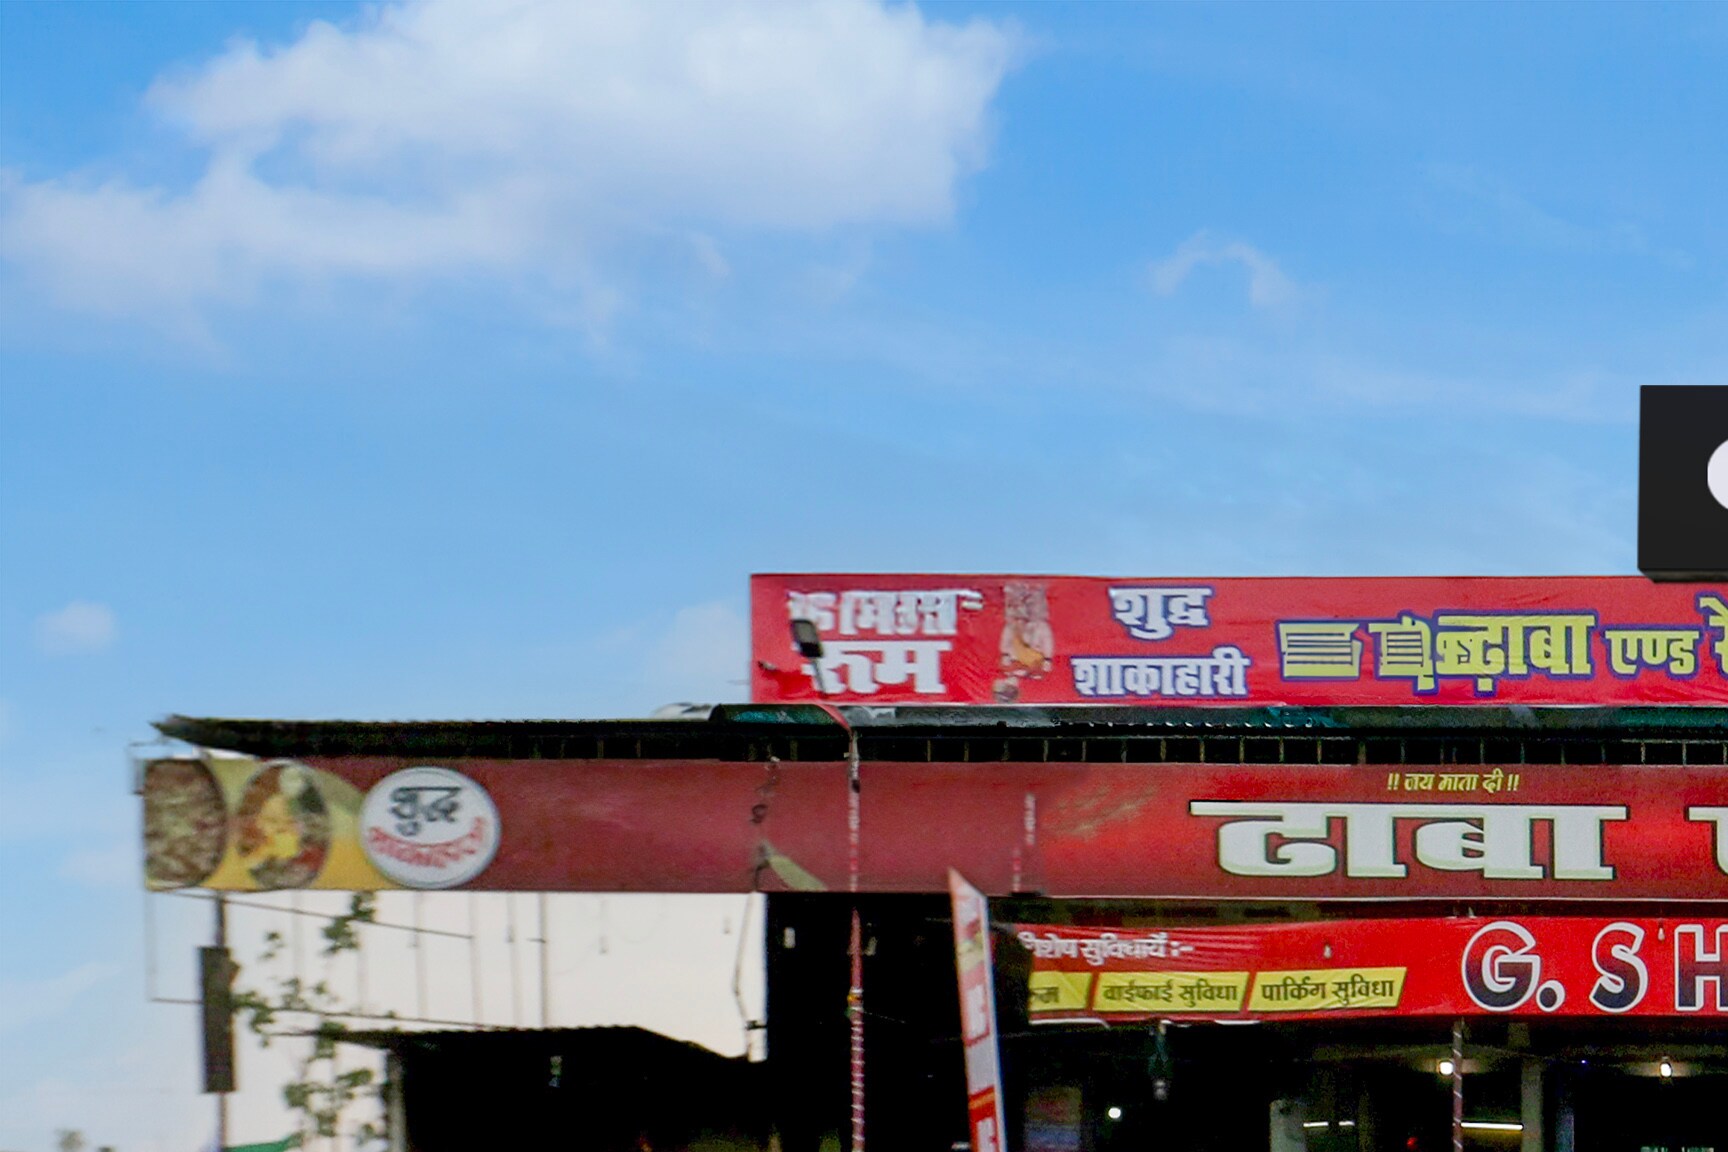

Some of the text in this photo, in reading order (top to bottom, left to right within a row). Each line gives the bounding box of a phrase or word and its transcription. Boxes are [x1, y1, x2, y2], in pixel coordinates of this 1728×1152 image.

[1110, 586, 1212, 638] शुद्ध
[1073, 646, 1250, 696] शाकाहारी
[1603, 627, 1703, 677] एण्ड
[1404, 773, 1435, 790] जय
[1438, 773, 1479, 791] माता
[1482, 767, 1504, 793] दी
[1190, 801, 1628, 881] ढाबा
[1332, 974, 1394, 1006] सुविधा
[1461, 921, 1566, 1012] G.
[1588, 922, 1649, 1012] S
[1178, 978, 1238, 1008] सुविधा
